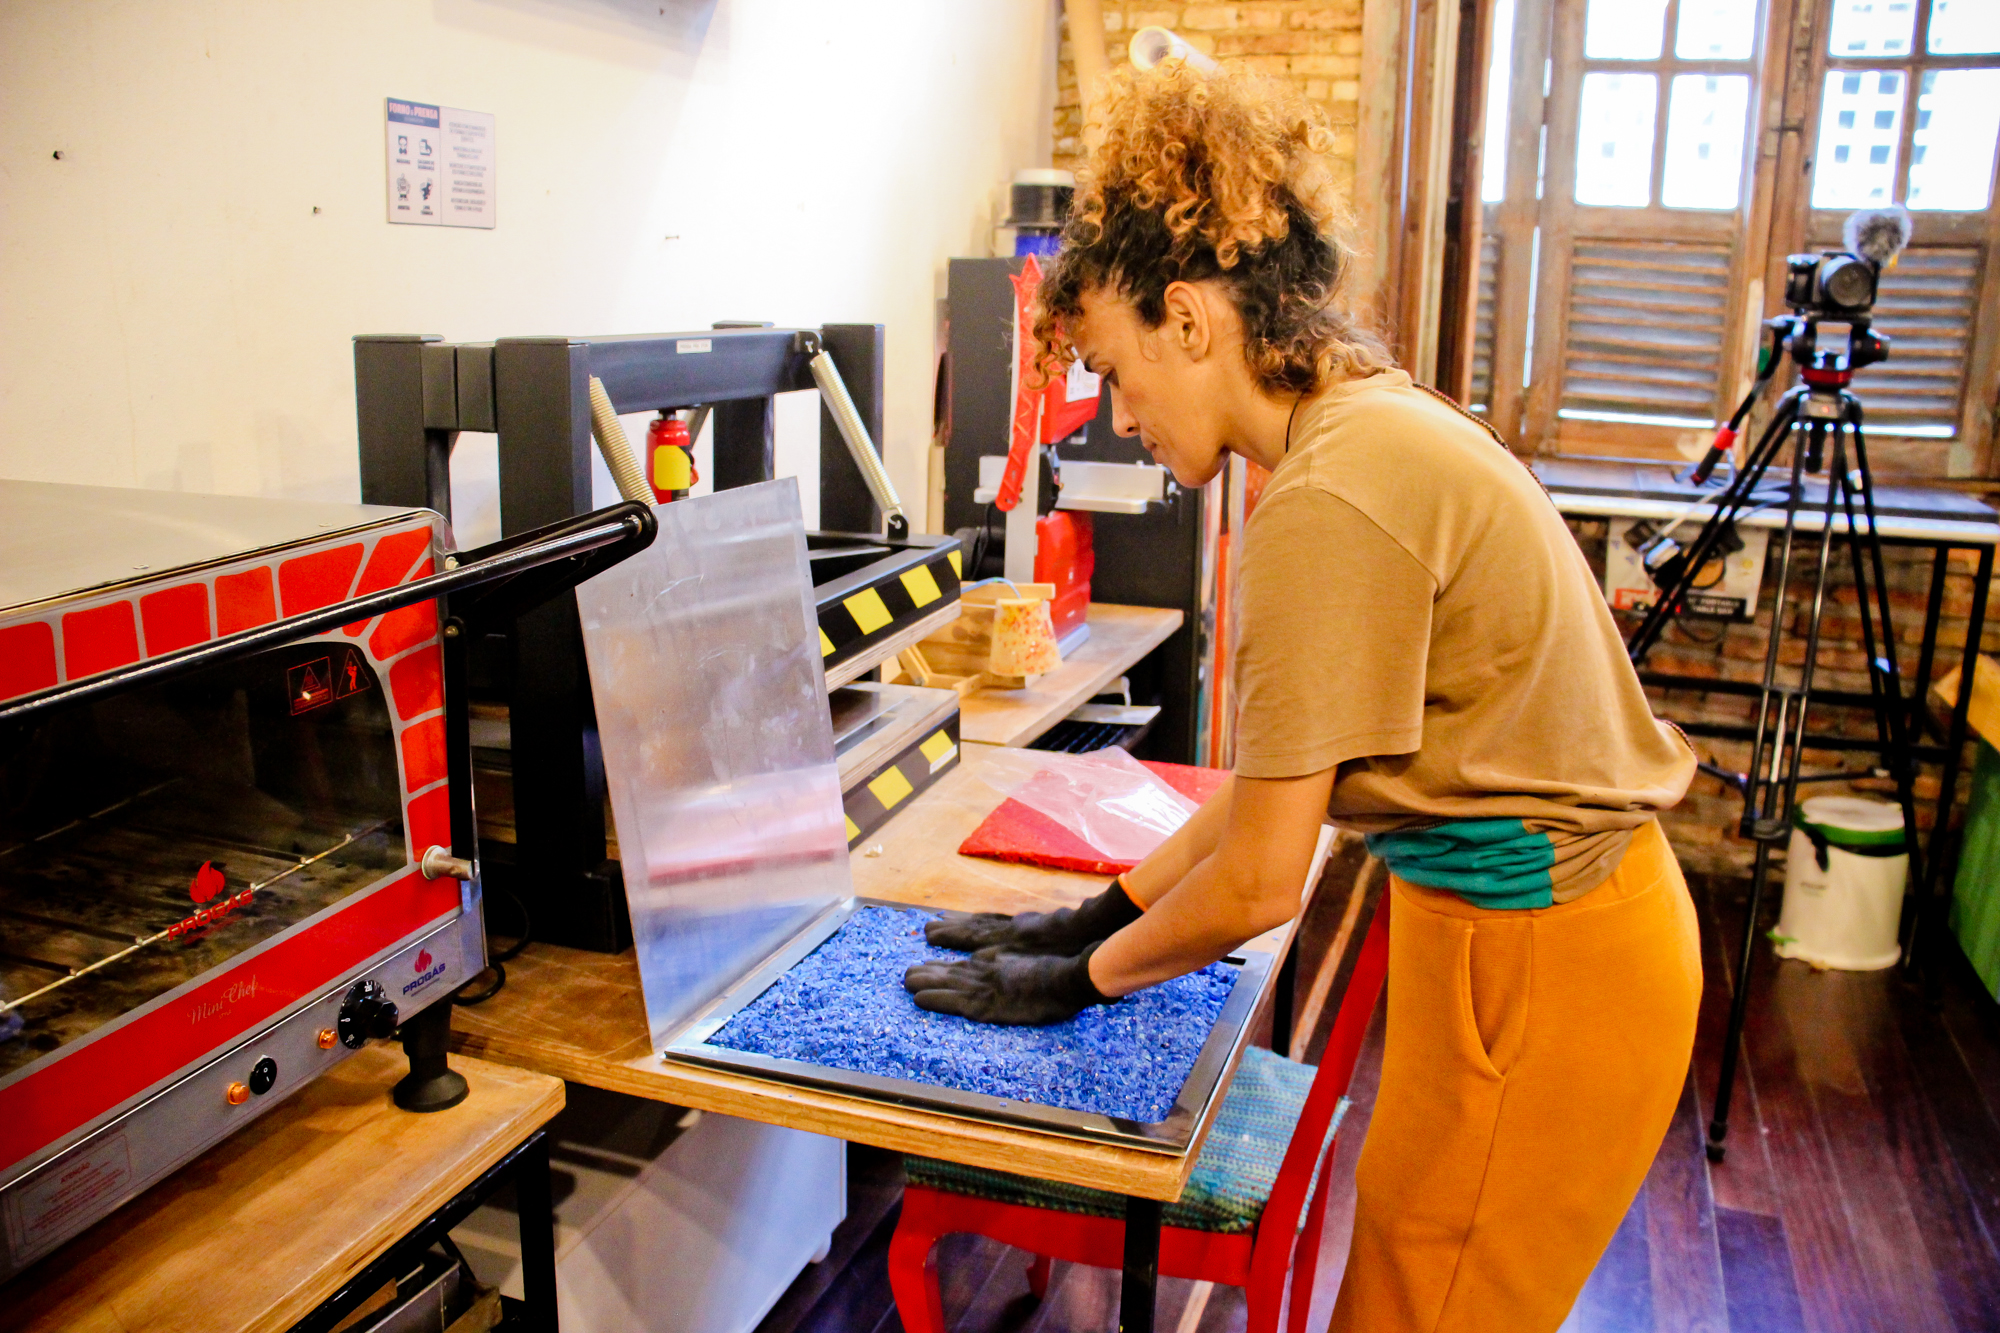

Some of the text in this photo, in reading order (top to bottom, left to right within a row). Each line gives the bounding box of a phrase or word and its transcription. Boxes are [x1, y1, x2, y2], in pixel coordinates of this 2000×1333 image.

[389, 102, 410, 116] FORNO
[414, 106, 438, 120] PRENSA
[403, 963, 446, 995] PROGÁS
[187, 997, 223, 1025] Mini
[222, 974, 259, 1003] Chef
